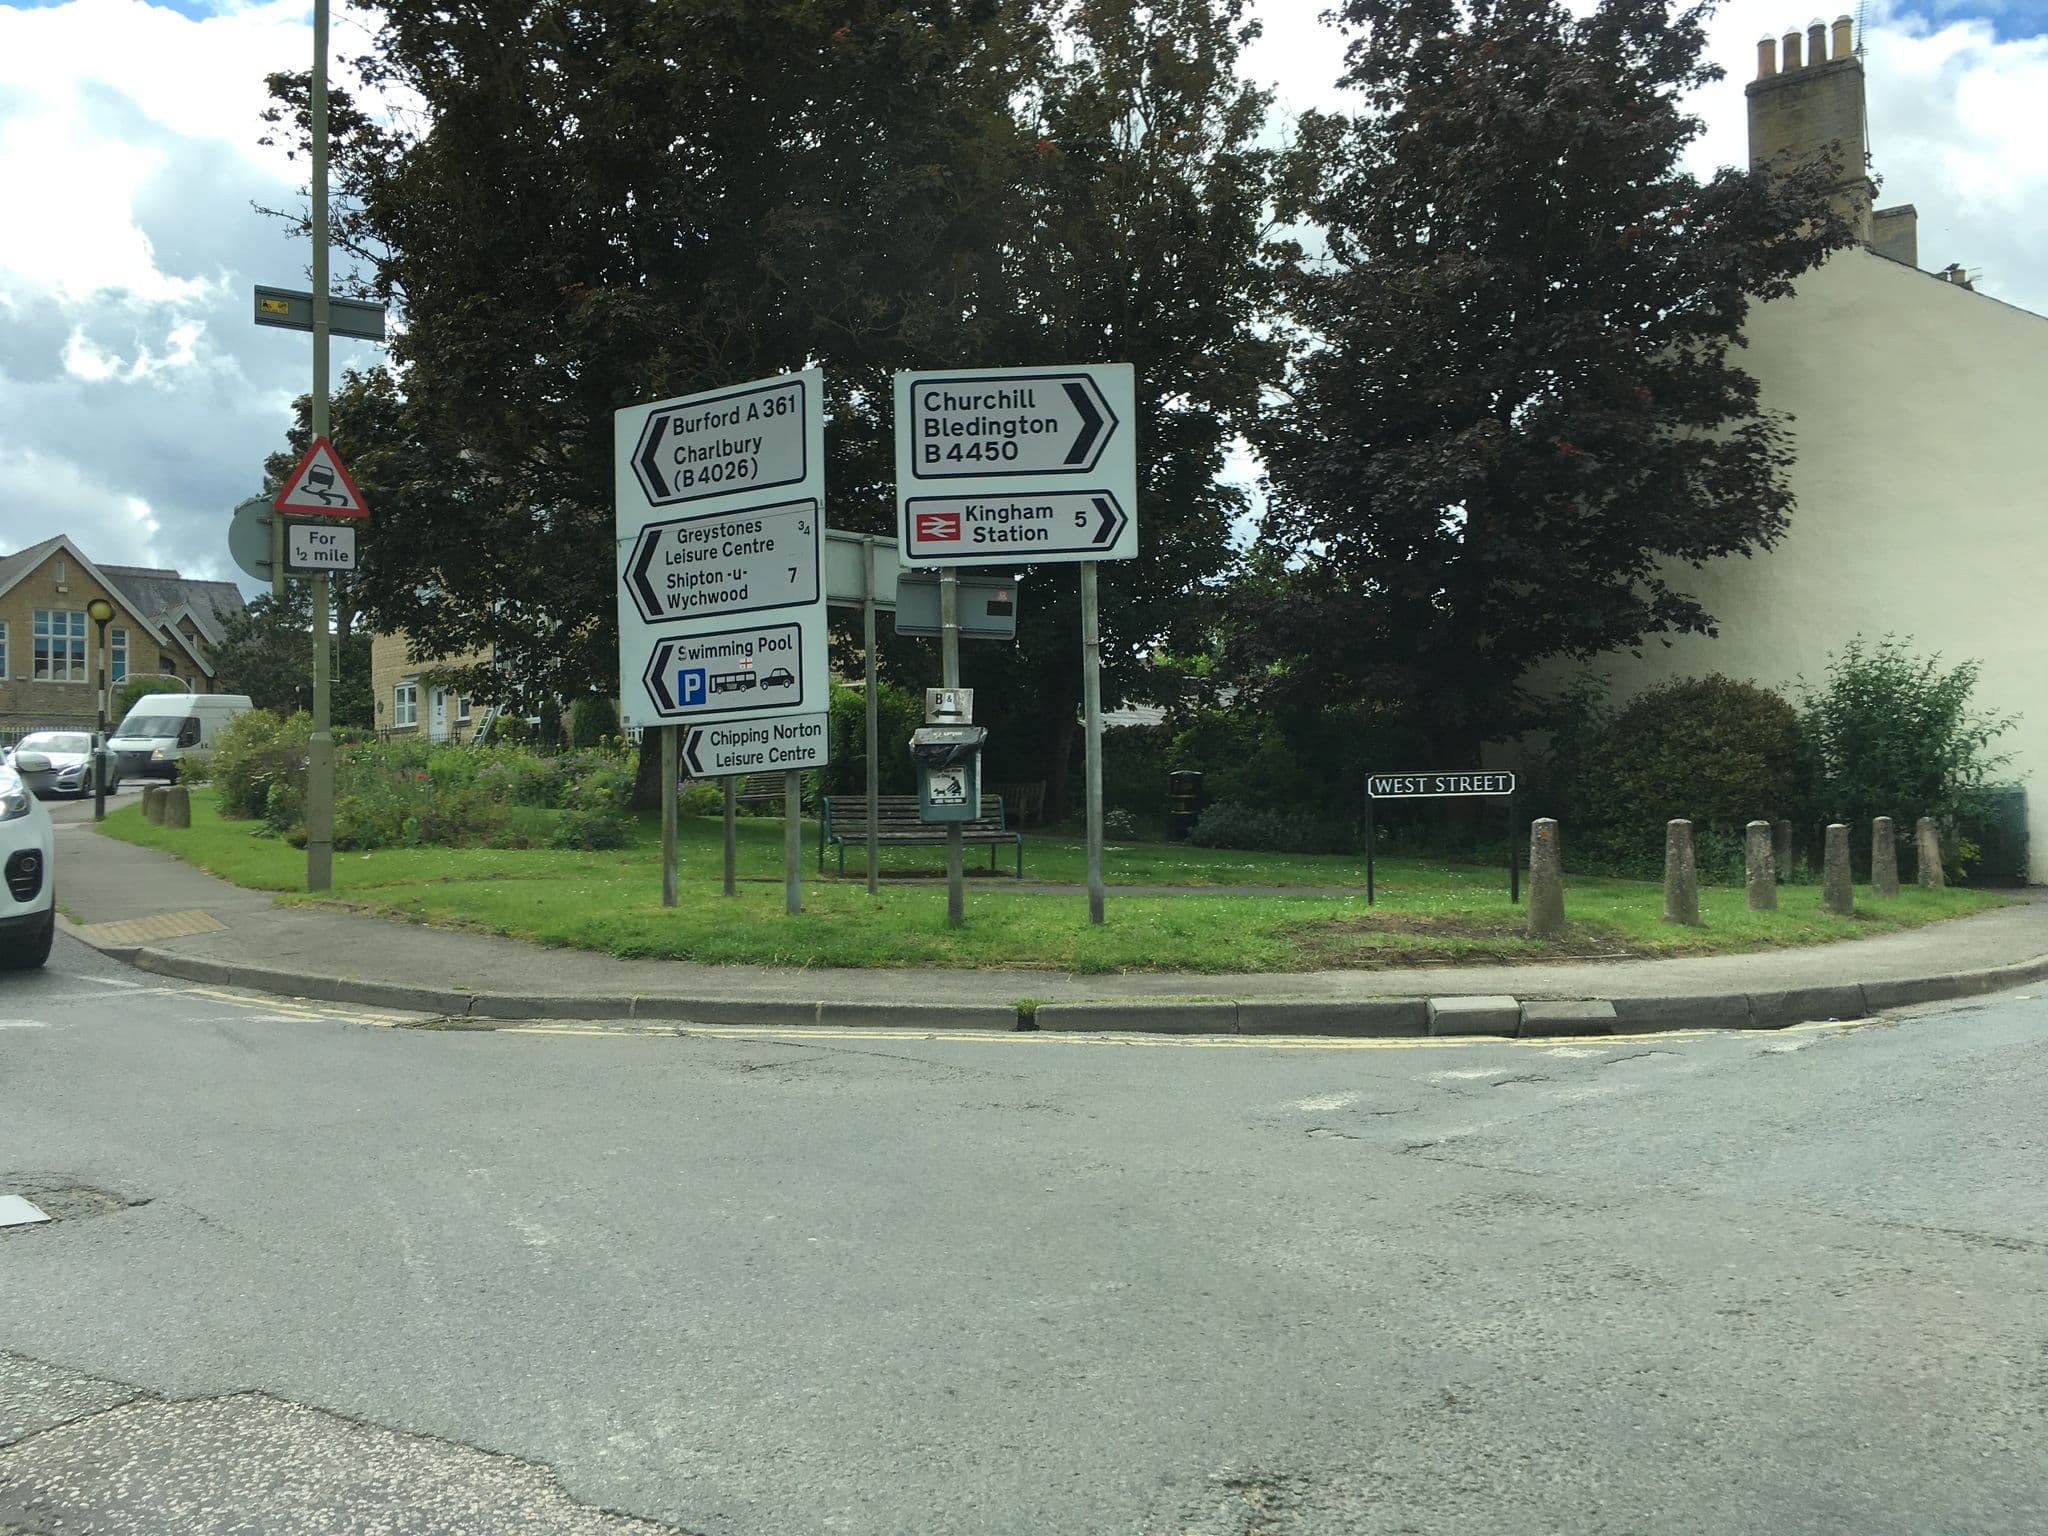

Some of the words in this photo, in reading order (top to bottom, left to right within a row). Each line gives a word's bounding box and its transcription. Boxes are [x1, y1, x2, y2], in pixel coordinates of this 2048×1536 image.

[924, 388, 1036, 412] Churchill
[673, 406, 740, 436] Burford
[924, 415, 1058, 438] Bledington
[674, 436, 762, 466] Charlbury
[965, 504, 1053, 524] Kingham
[1074, 511, 1087, 528] 5
[309, 531, 336, 545] For
[677, 520, 762, 544] Greystones
[973, 525, 1049, 543] Station
[314, 549, 349, 562] mile
[665, 544, 718, 566] Leisure
[722, 536, 775, 556] Centre
[667, 569, 723, 590] Shipton
[788, 567, 798, 583] 7
[667, 584, 748, 611] Wychwood
[678, 640, 753, 661] Swimming
[758, 634, 793, 653] Pool
[684, 673, 701, 702] P
[710, 728, 769, 748] Chipping
[774, 722, 821, 740] Norton
[716, 750, 763, 767] Leisure
[769, 746, 816, 762] Centre
[1375, 778, 1428, 793] WEST
[1435, 775, 1507, 792] STREET
